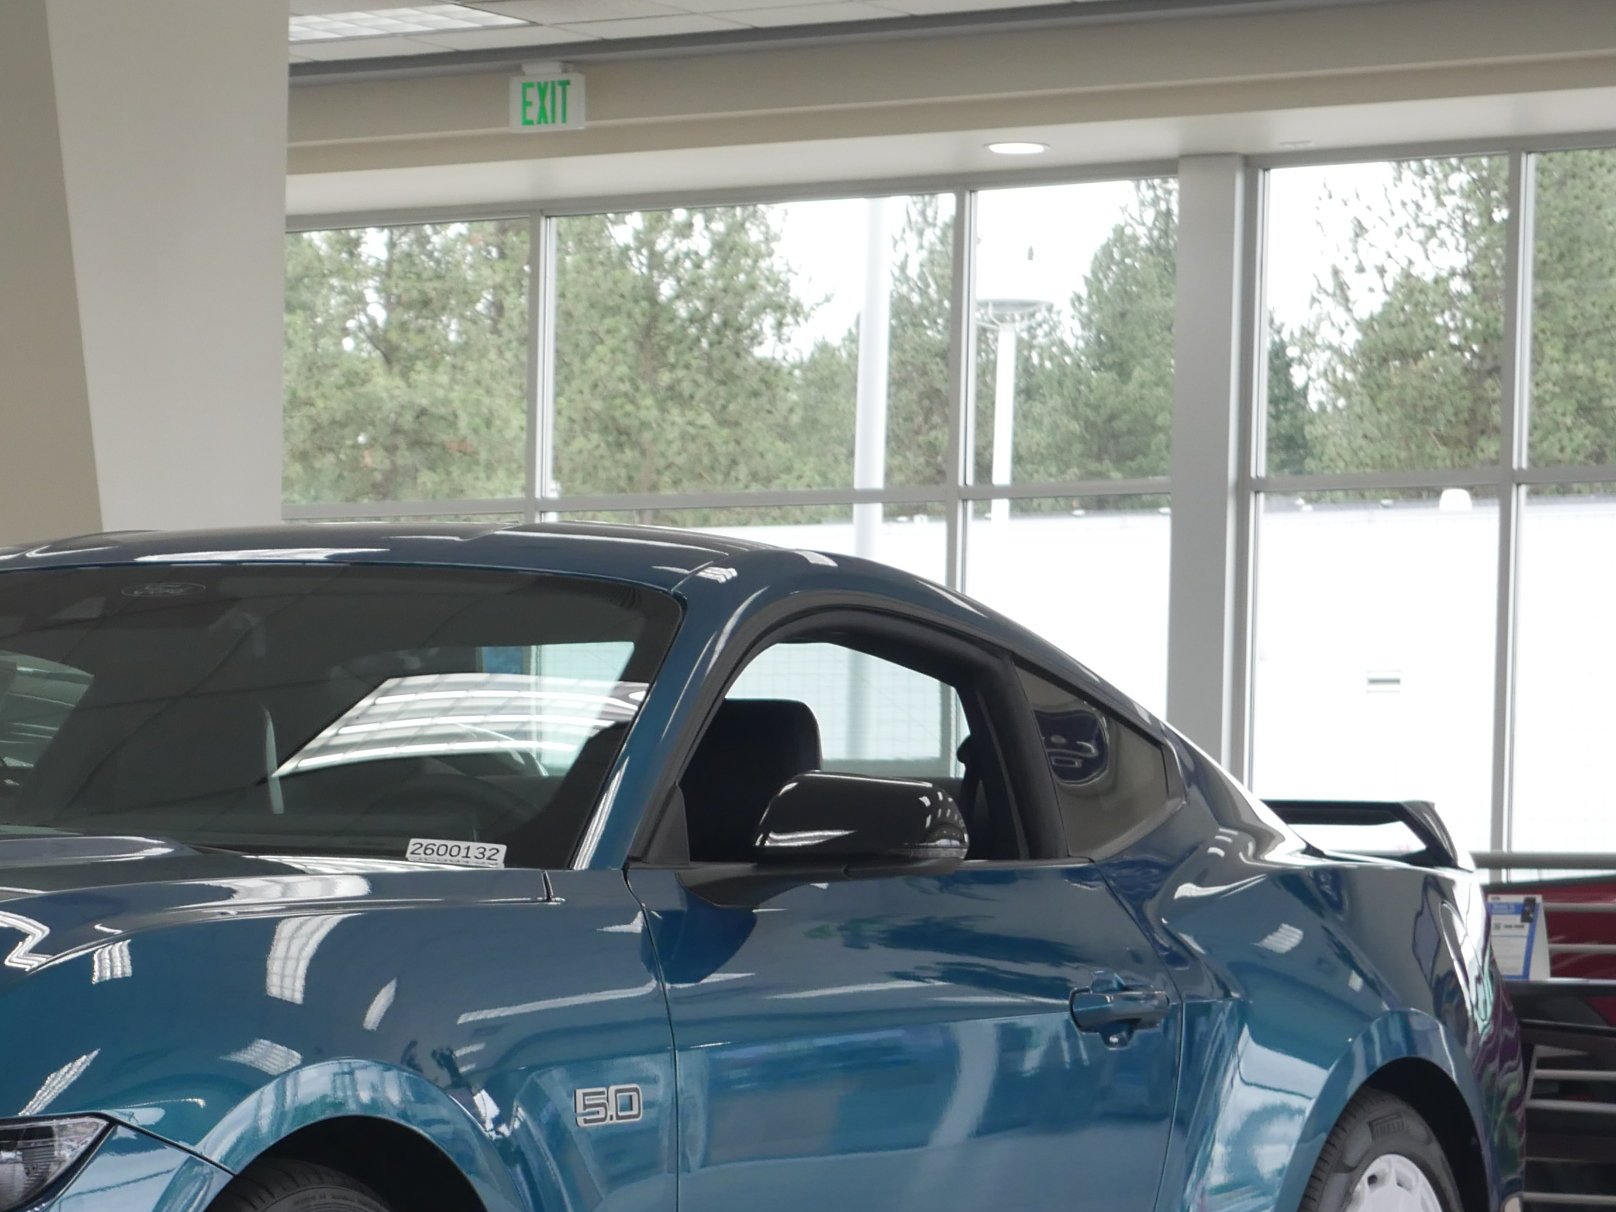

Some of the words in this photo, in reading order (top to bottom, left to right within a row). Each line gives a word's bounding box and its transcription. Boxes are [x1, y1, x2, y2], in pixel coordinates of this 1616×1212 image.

[521, 79, 571, 126] EXIT
[409, 842, 500, 861] 2600132
[574, 1084, 643, 1128] 5.0
